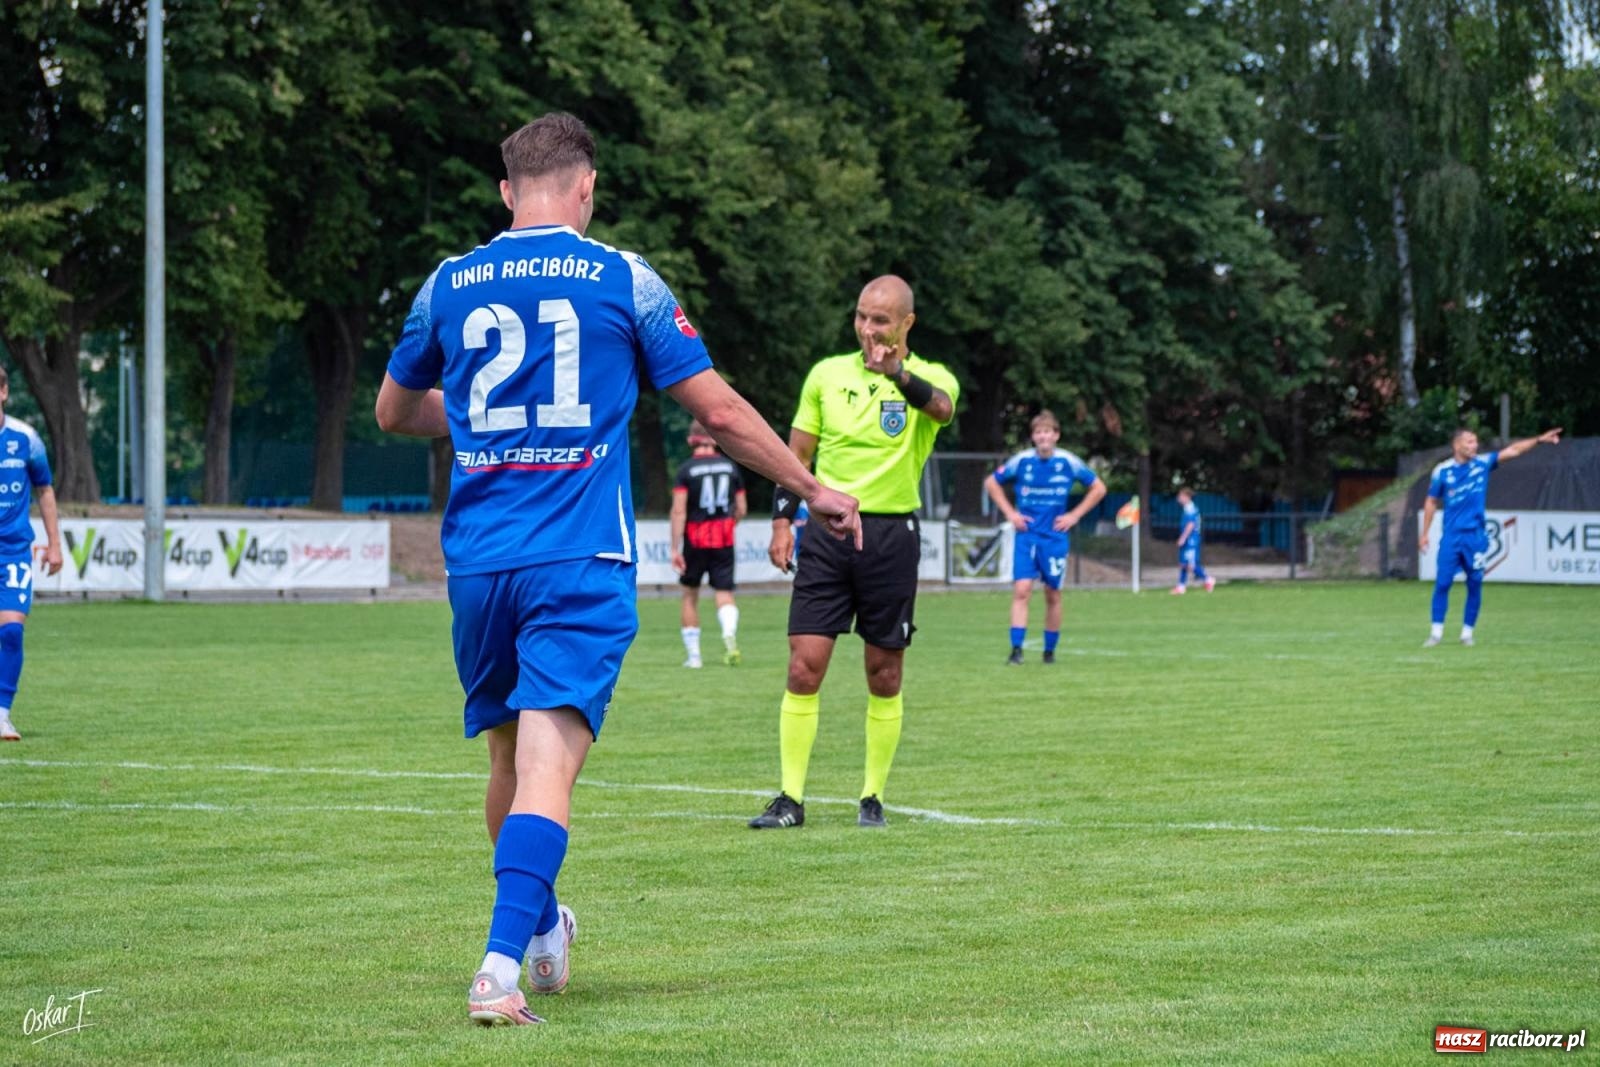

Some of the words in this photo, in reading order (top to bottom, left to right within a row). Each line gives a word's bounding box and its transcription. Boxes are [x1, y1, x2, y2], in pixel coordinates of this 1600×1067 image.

[451, 262, 495, 290] UNIA
[501, 254, 605, 282] RACIBÓRZ
[462, 298, 592, 433] 21
[699, 473, 730, 515] 44
[63, 527, 138, 580] V4cup
[218, 527, 289, 579] V4cup
[1547, 558, 1600, 574] UBEZ
[5, 562, 31, 589] 17
